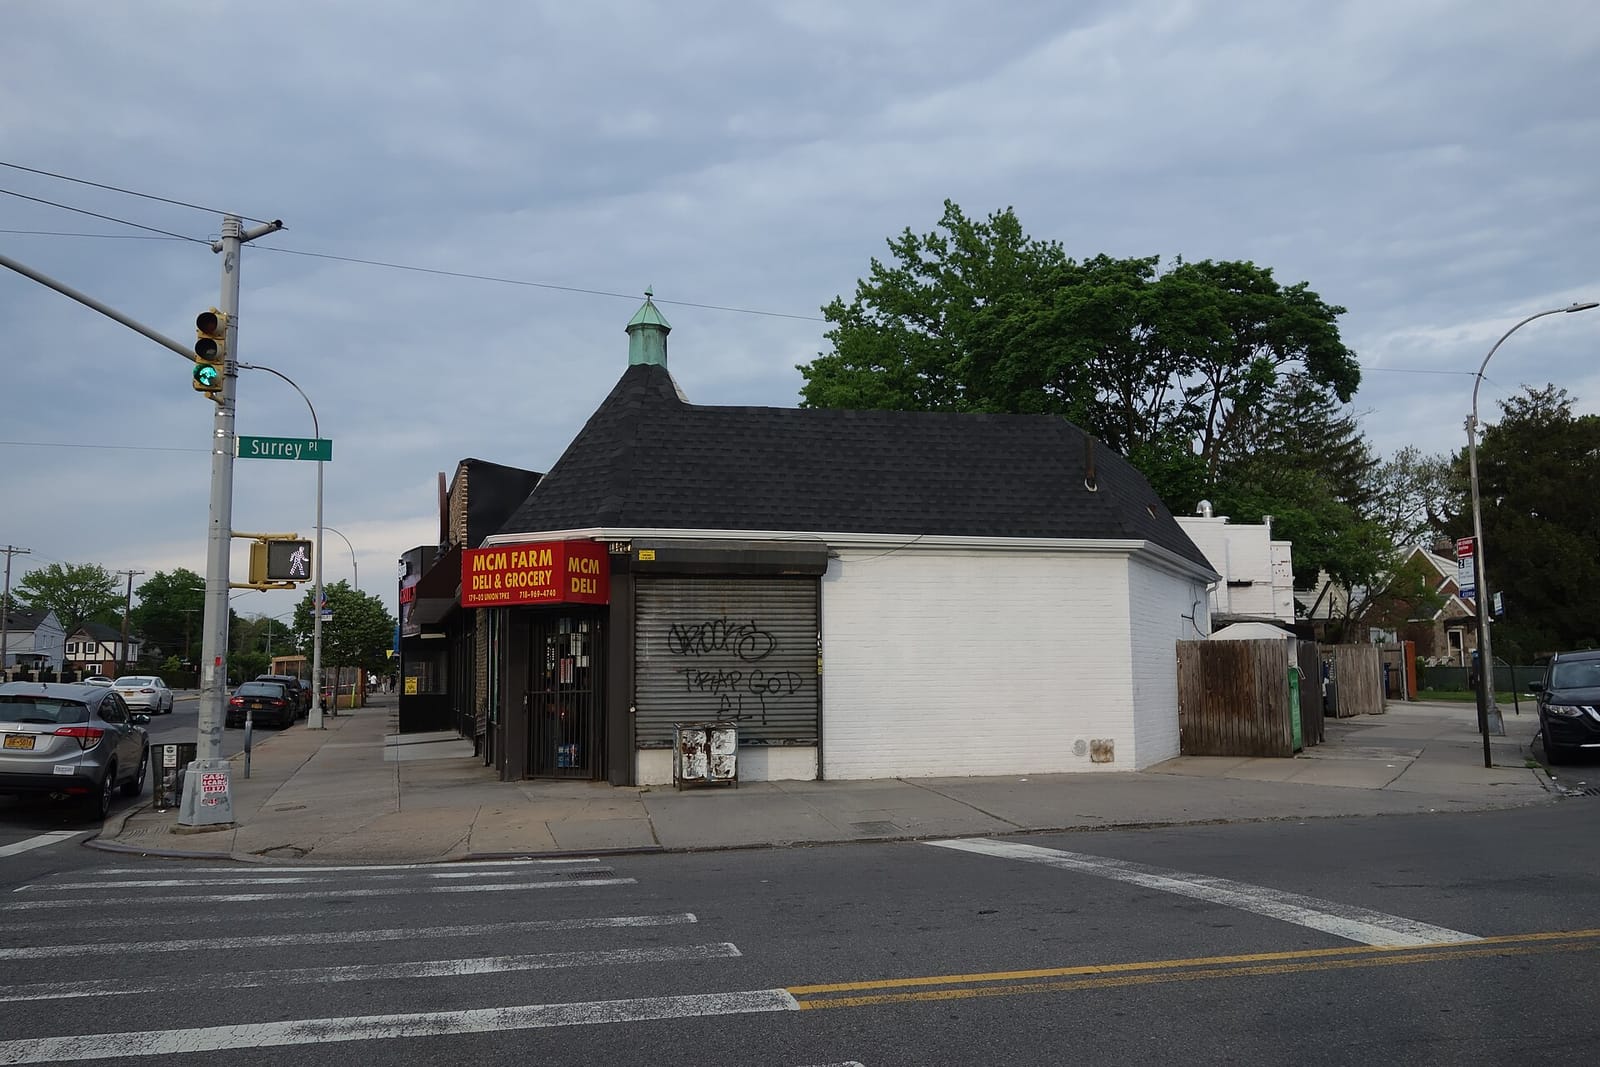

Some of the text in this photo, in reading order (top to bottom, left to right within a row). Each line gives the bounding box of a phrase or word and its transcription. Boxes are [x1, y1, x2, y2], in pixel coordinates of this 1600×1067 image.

[251, 440, 318, 460] Surrey Pl
[472, 549, 553, 572] MCM FARM
[568, 556, 600, 575] MCM
[472, 570, 553, 590] DELI & GROCERY
[571, 577, 597, 594] DELI
[484, 592, 499, 601] UNION
[499, 591, 510, 600] TPKE
[676, 668, 803, 695] TRAP GOD
